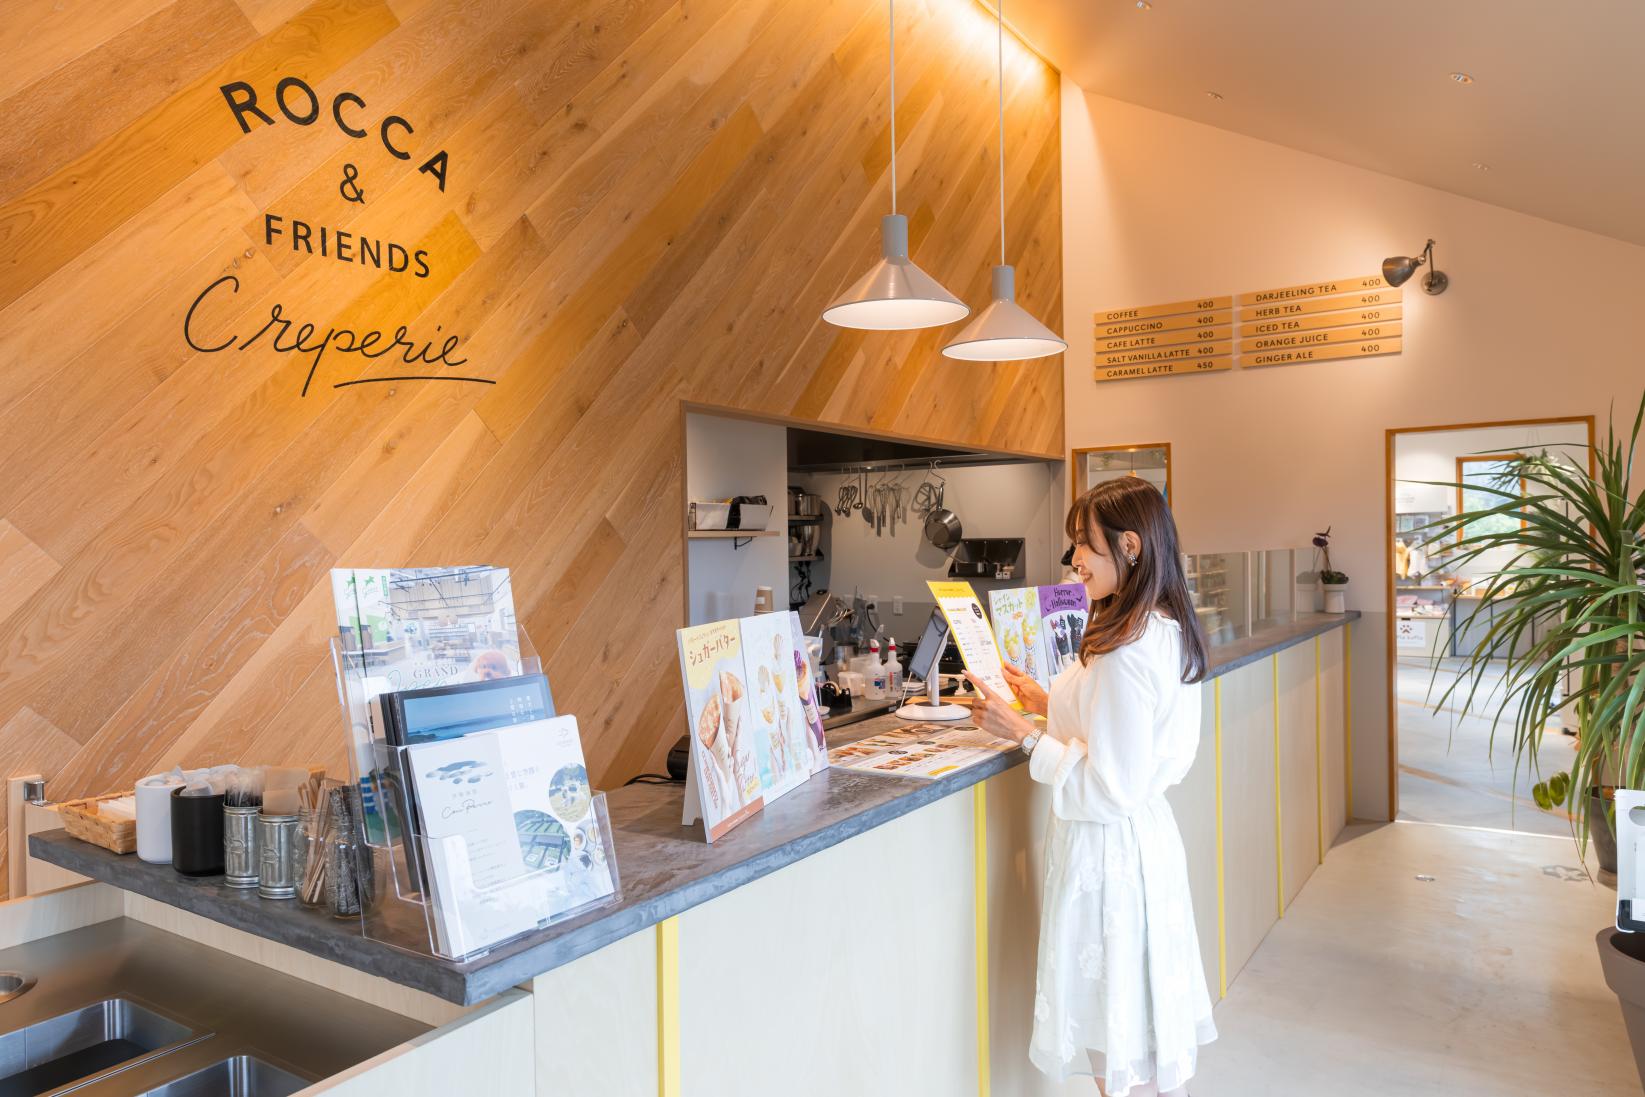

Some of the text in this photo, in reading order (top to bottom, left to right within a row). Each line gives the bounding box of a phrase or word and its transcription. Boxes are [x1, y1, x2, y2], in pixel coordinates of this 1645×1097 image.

[219, 76, 449, 193] ROCCA
[339, 163, 366, 205] &
[265, 213, 430, 279] FRIENDS
[1255, 278, 1381, 302] DARJEELING TEA 400
[1106, 301, 1214, 321] COFFEE 400
[1255, 295, 1380, 317] HERB TEA 400
[1106, 316, 1214, 335] CAPPUCCINO 400
[1255, 312, 1380, 333] ICED TEA 400
[184, 275, 468, 398] Creperie
[1106, 331, 1214, 349] CAFE LATTE 400
[1255, 328, 1380, 349] ORANGE JUICE 400
[1106, 346, 1214, 364] SALT VANILLA LATTE 400
[1255, 344, 1380, 364] GINGER ALE 400
[1106, 361, 1213, 378] CARAMEL LATTE 450
[689, 634, 736, 667] シュガーバター
[413, 666, 458, 679] GRAND
